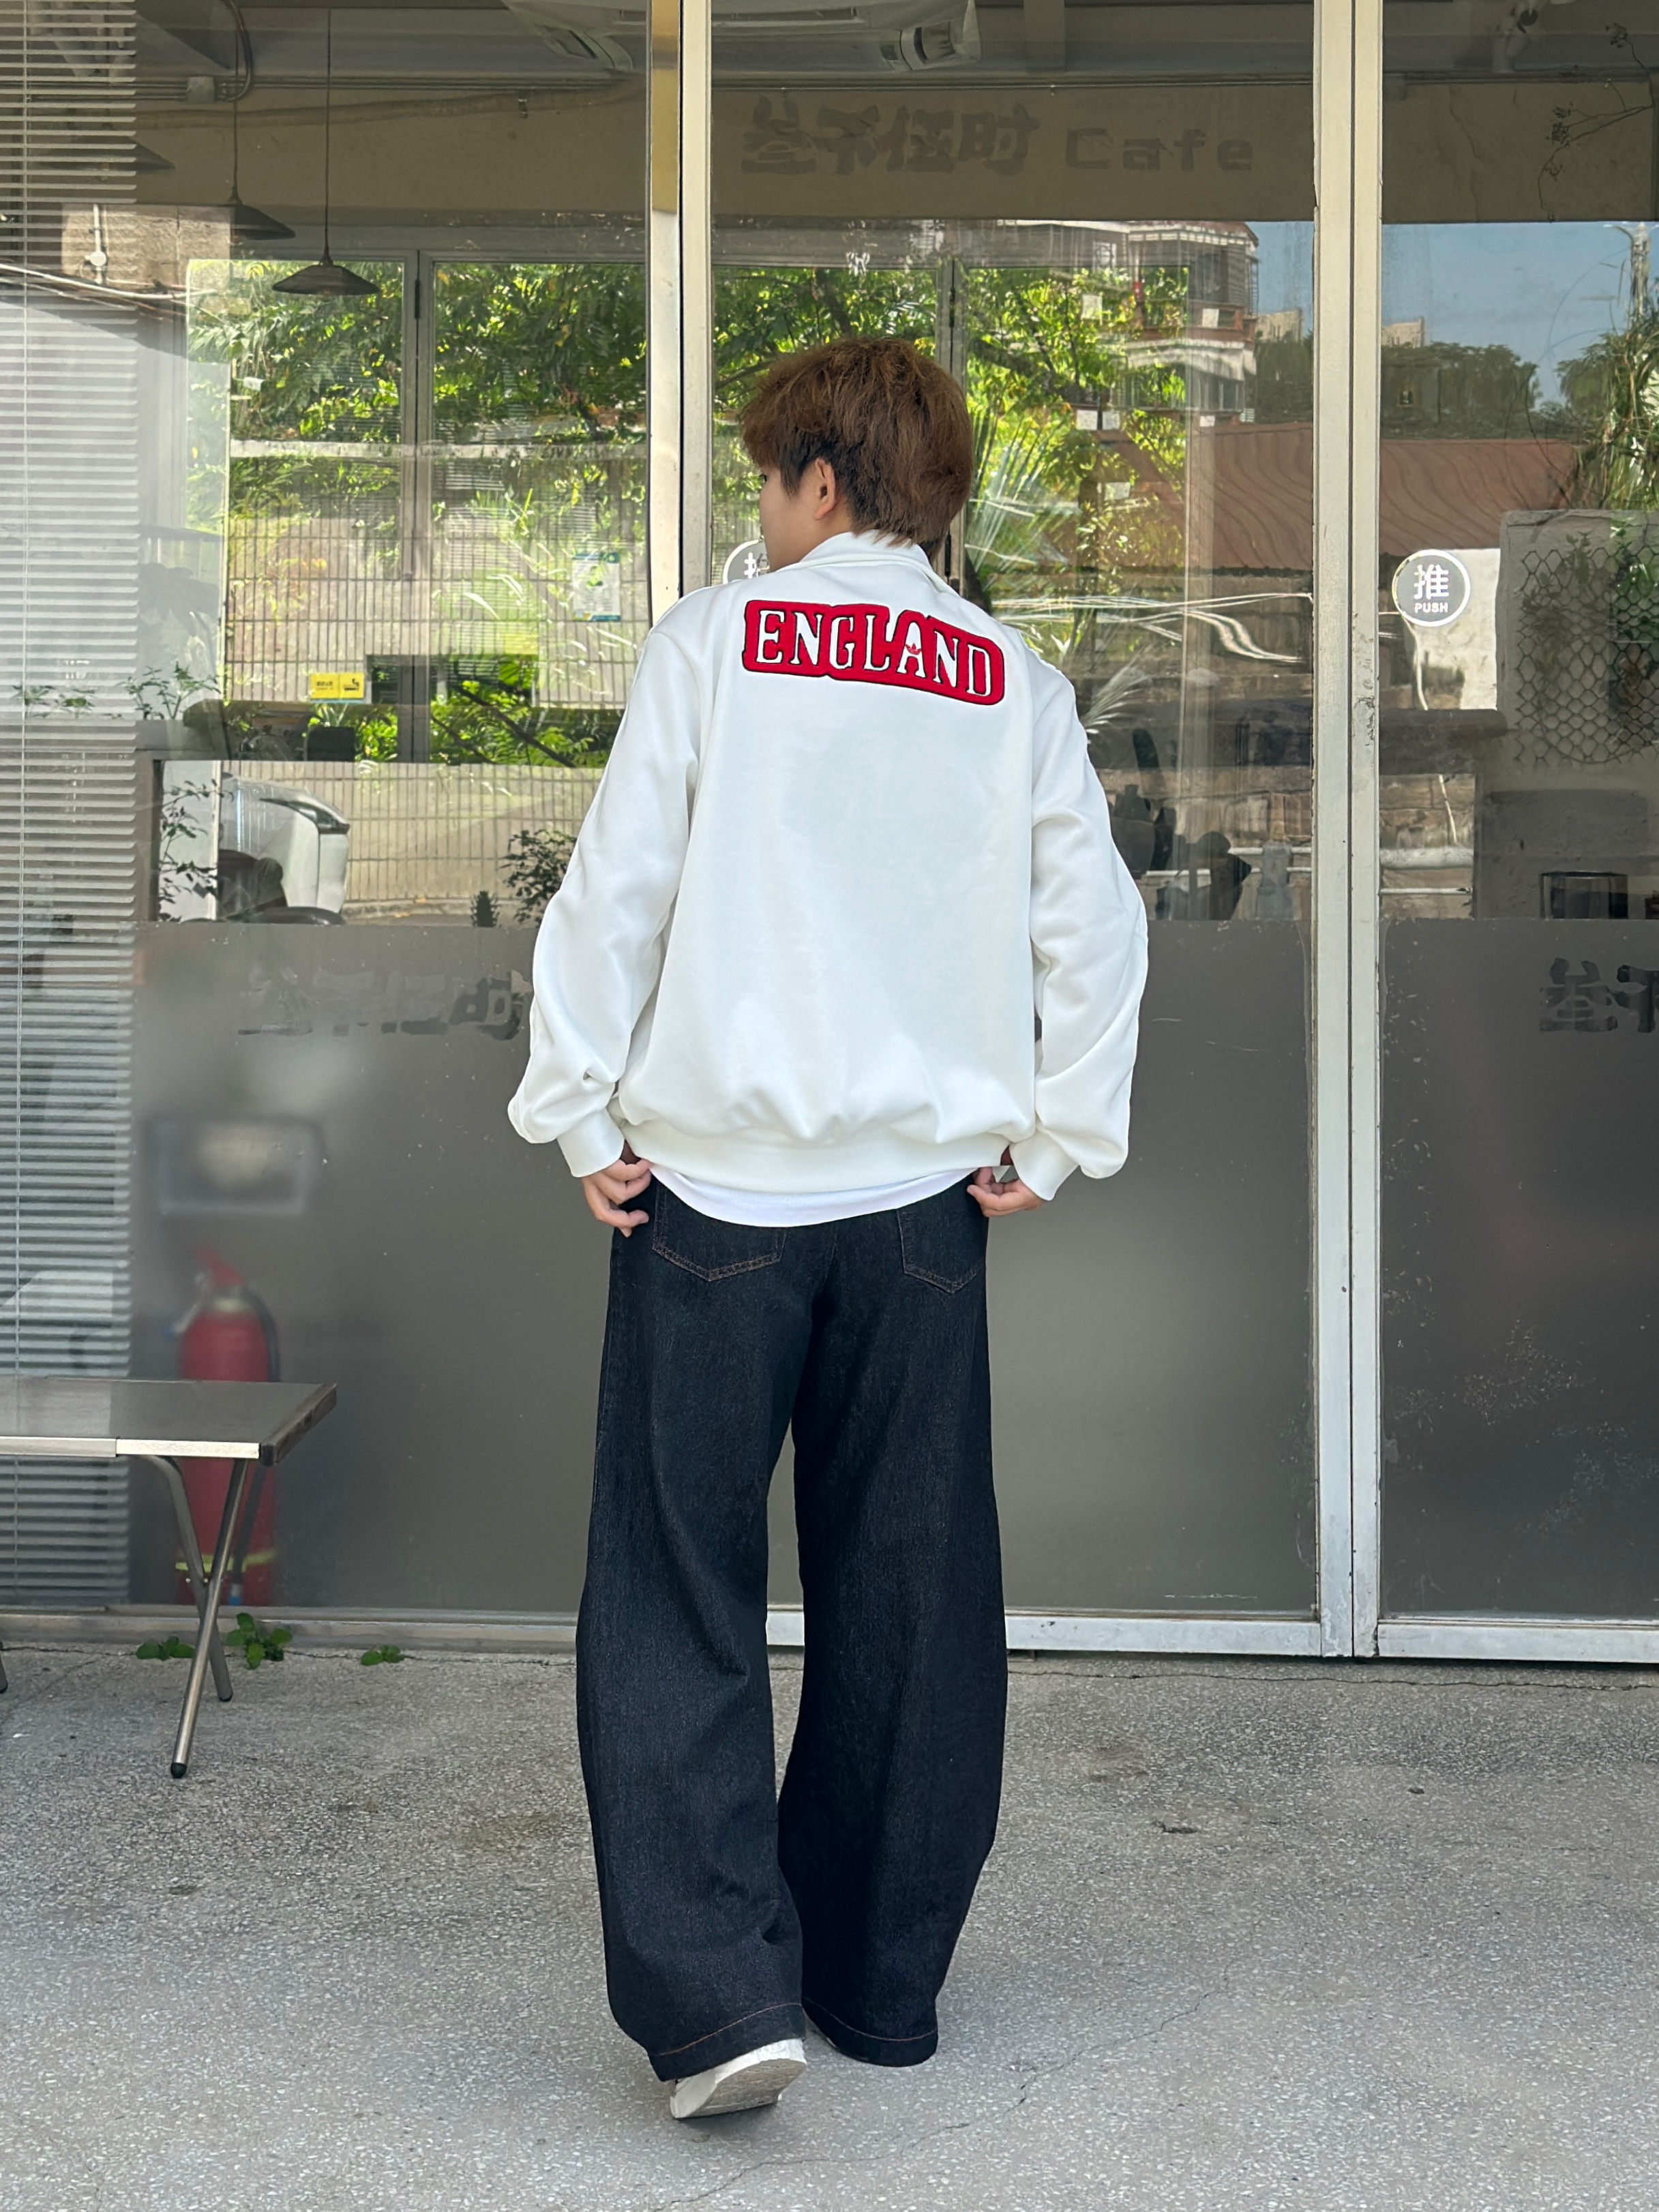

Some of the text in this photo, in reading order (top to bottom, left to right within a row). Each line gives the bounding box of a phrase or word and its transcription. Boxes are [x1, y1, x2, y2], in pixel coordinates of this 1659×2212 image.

[1066, 127, 1253, 170] Cafe
[1414, 564, 1449, 599] 推
[1414, 602, 1449, 613] PUSH
[755, 609, 992, 697] ENGLAND
